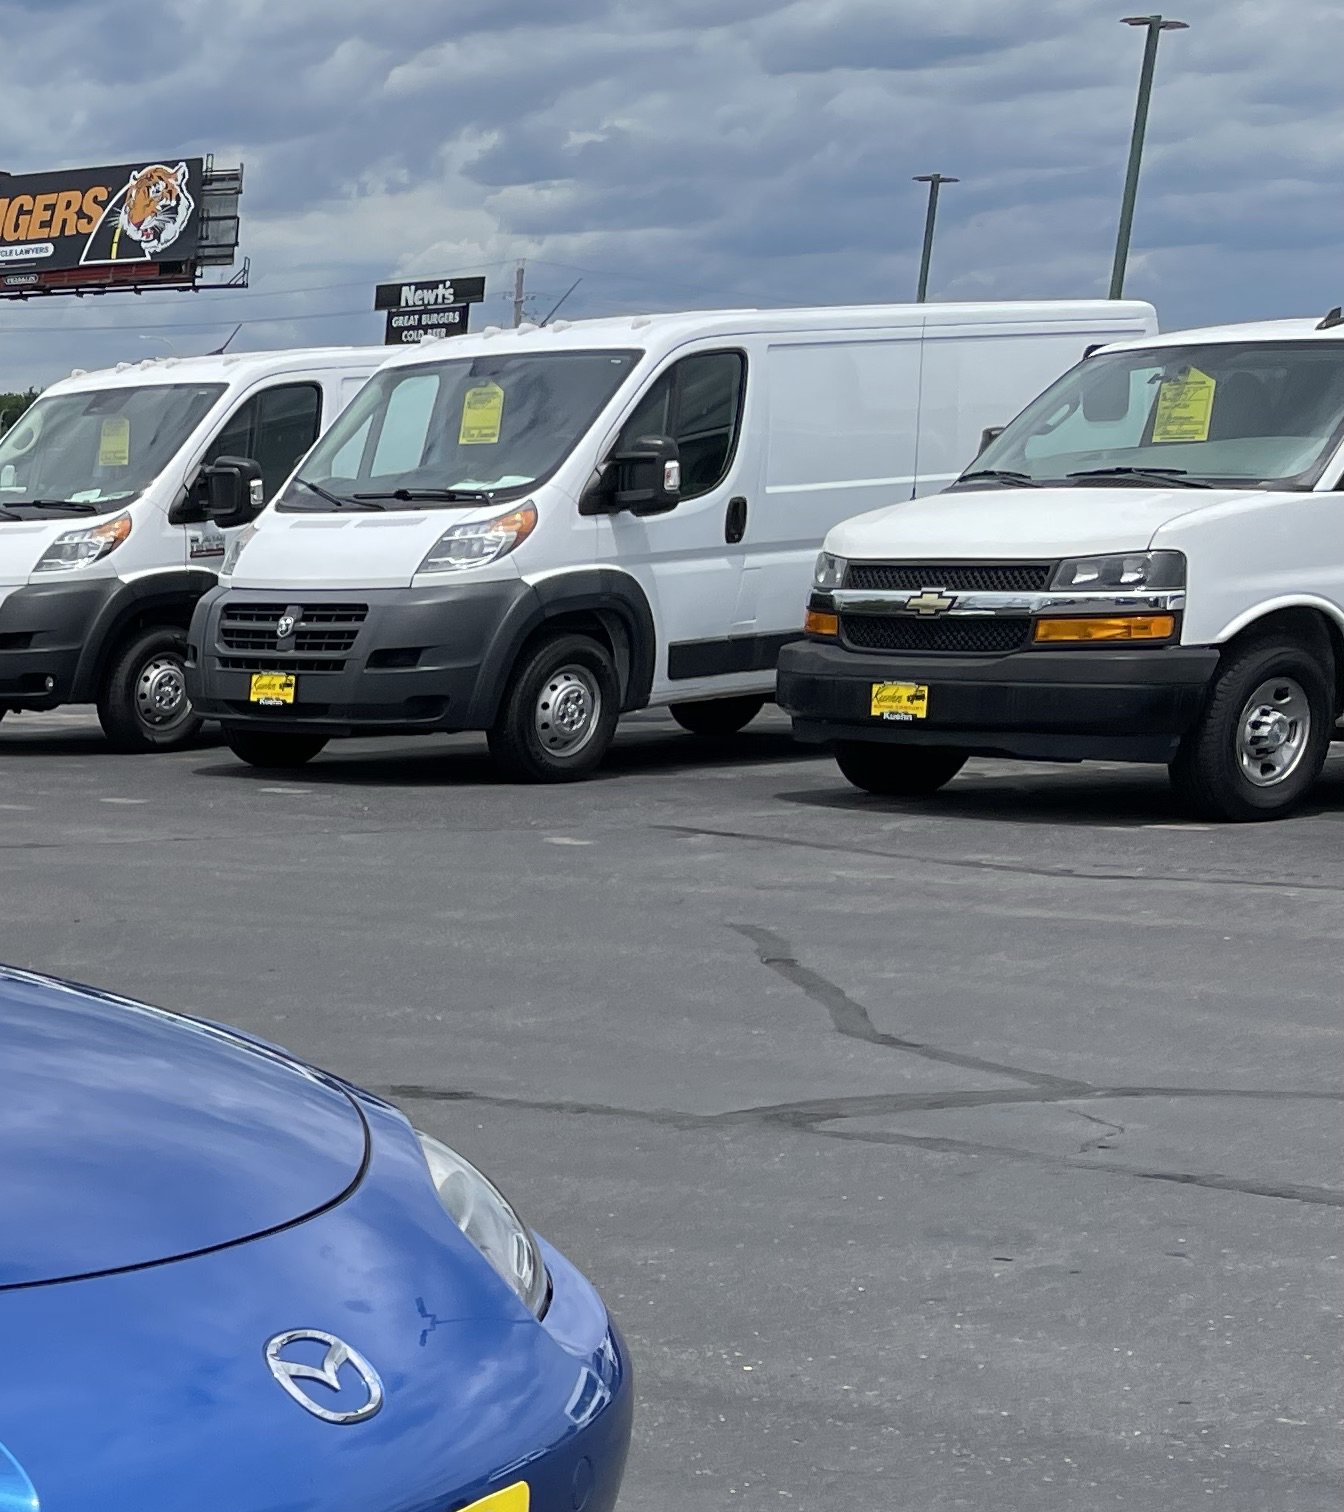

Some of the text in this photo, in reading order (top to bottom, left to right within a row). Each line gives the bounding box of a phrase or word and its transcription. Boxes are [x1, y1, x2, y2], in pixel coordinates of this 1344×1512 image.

[14, 246, 50, 257] LAWYERS
[401, 280, 455, 307] Newt's
[392, 311, 460, 328] GREAT BURGERS
[402, 329, 425, 342] COLD
